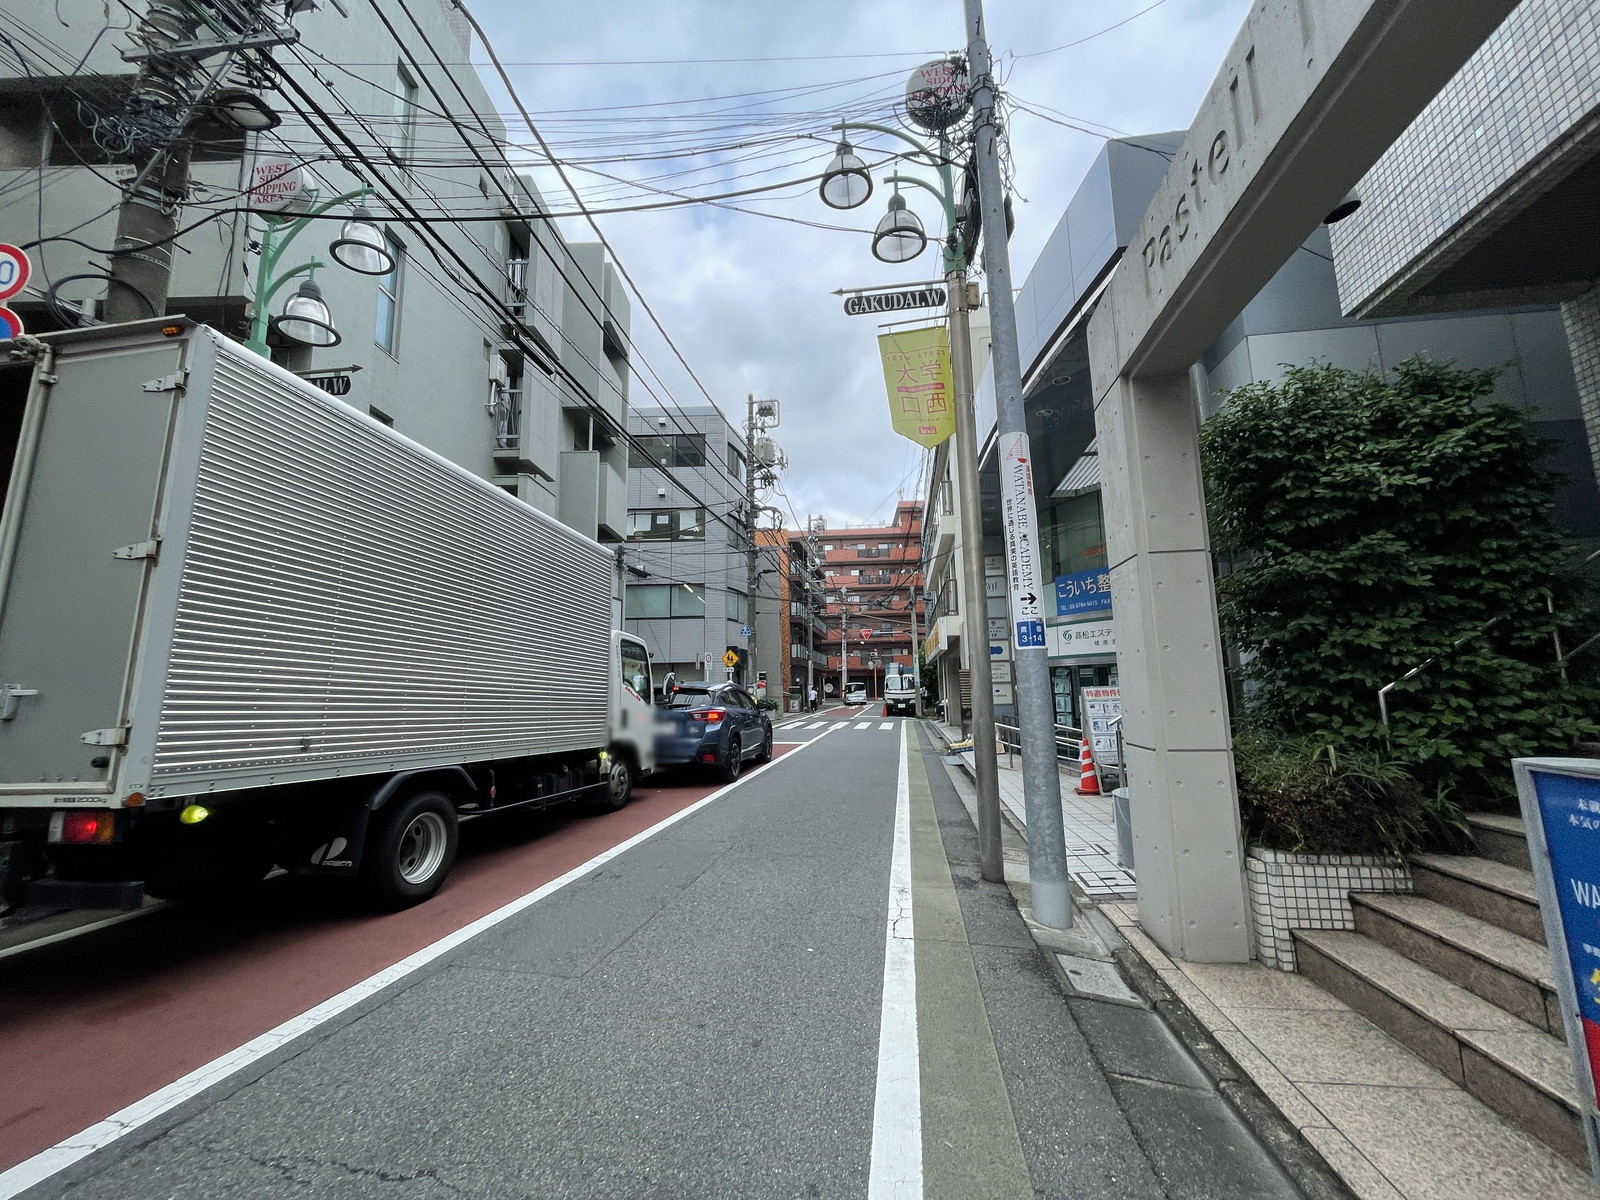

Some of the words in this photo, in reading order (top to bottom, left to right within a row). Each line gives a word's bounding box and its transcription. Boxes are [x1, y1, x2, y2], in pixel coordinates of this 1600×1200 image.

[256, 163, 290, 175] WEST
[847, 289, 942, 314] GAKUDAI.W
[1014, 464, 1028, 529] WATANABE
[1058, 574, 1111, 598] こういち整
[1570, 878, 1600, 910] WA
